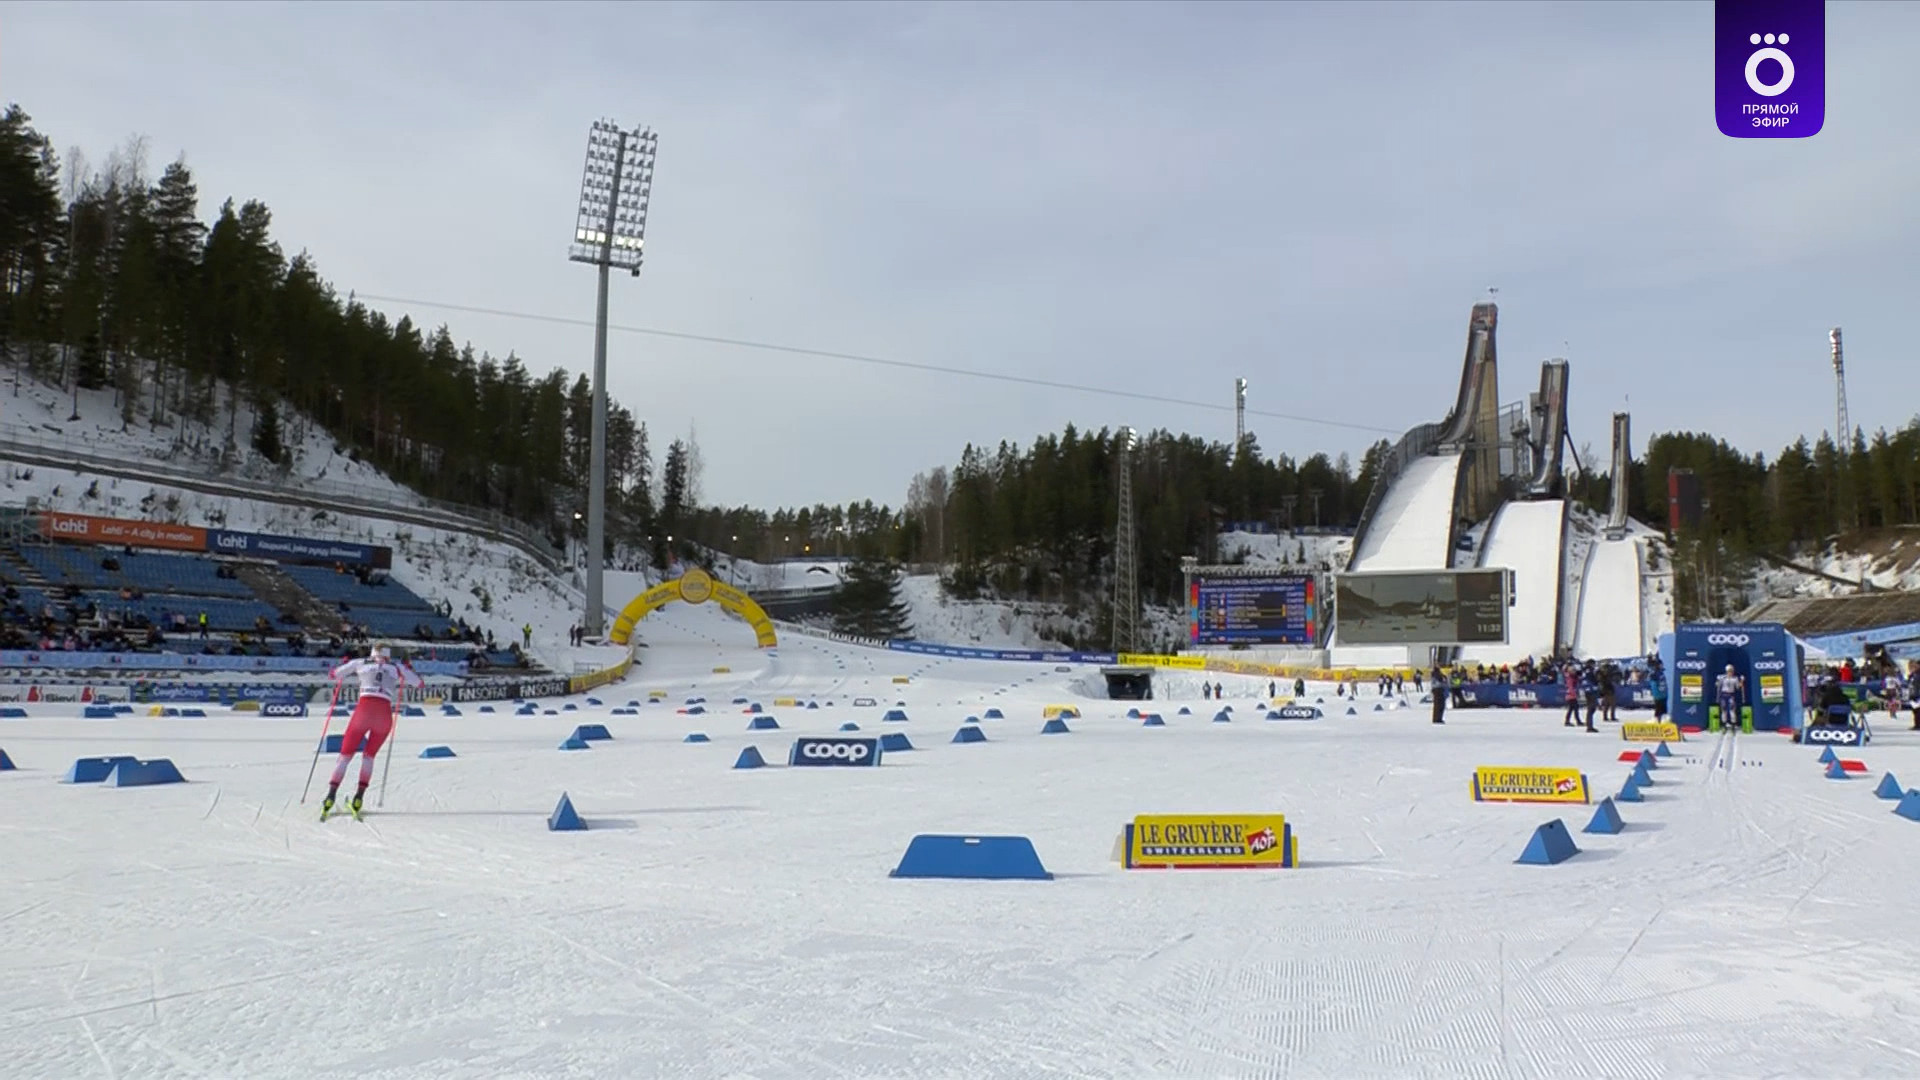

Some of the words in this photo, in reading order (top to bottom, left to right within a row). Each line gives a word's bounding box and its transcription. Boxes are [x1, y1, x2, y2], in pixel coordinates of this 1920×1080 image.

[52, 517, 89, 534] Lahti
[101, 524, 124, 536] Lahti
[131, 527, 140, 538] A
[140, 528, 156, 541] city
[157, 531, 165, 539] in
[166, 531, 195, 543] motion
[217, 533, 248, 550] Lahti
[1707, 634, 1750, 647] coop
[1676, 660, 1707, 671] coop
[1754, 660, 1786, 671] coop
[267, 704, 301, 715] coop
[1282, 708, 1312, 718] coop
[1811, 729, 1857, 743] coop
[803, 743, 868, 762] coop
[1483, 772, 1497, 786] LE
[1499, 771, 1554, 787] GRUYÈRE
[1140, 823, 1161, 844] LE
[1165, 821, 1245, 844] GRUYÈRE
[1251, 832, 1277, 852] AOP
[1146, 847, 1242, 855] SWITZERLAND
